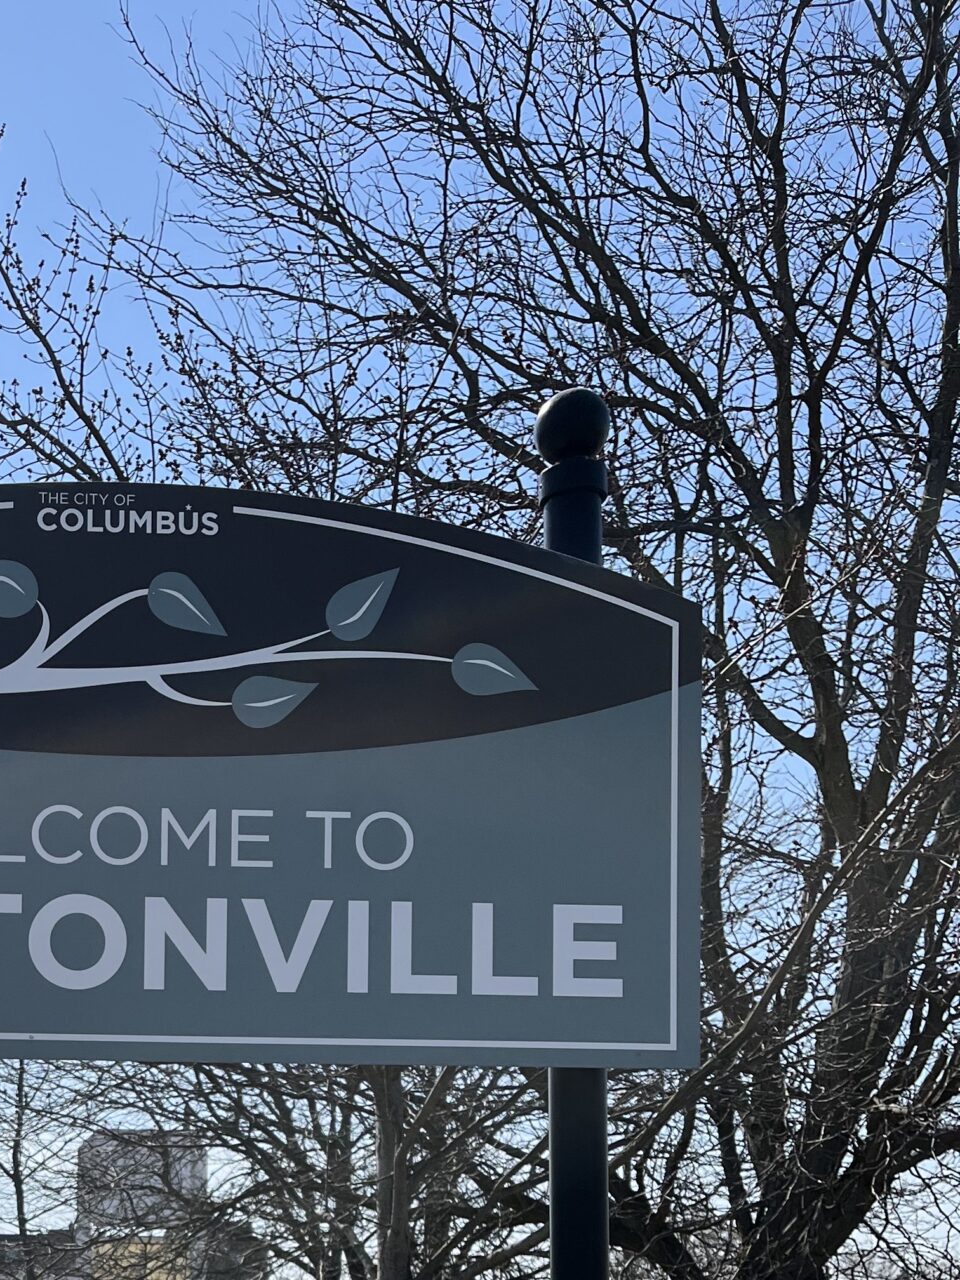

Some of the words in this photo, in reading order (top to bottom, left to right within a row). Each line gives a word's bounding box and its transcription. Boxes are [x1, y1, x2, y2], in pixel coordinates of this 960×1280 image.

[38, 491, 69, 504] THE
[73, 492, 109, 506] CITY
[113, 493, 136, 506] OF
[37, 507, 219, 536] COLUMBUS
[305, 809, 414, 871] TO
